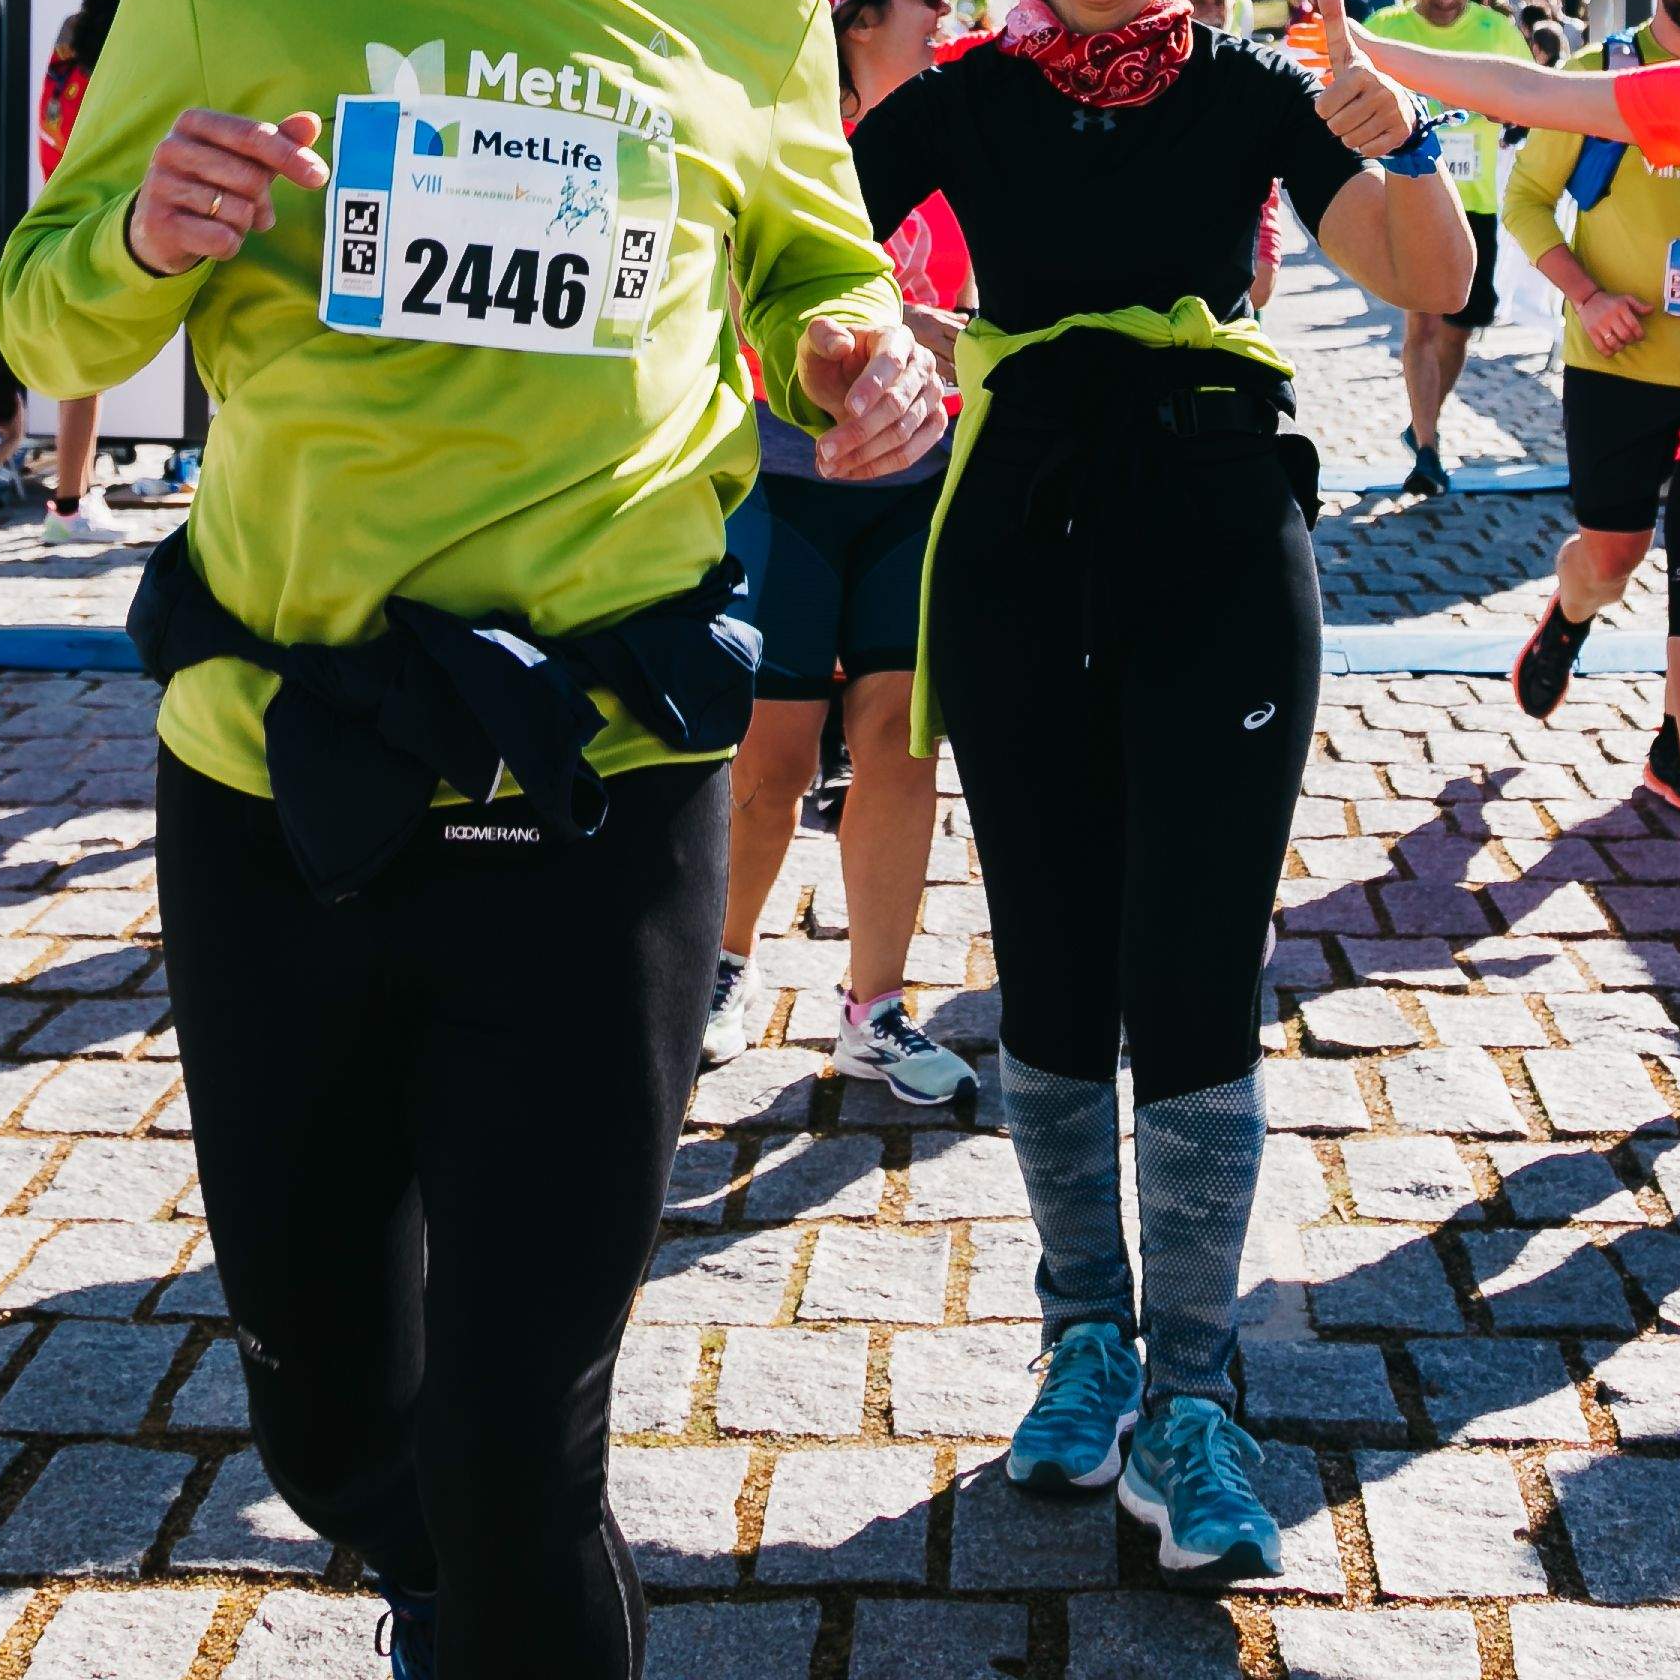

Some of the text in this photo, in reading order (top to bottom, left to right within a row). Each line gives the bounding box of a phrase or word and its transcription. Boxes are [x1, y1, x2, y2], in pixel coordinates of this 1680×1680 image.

[466, 48, 674, 142] MetLife
[472, 129, 603, 172] MetLife
[411, 172, 442, 195] VIII
[472, 189, 513, 202] MADRID
[401, 237, 591, 330] 2446
[444, 824, 540, 843] BOOMERANG
